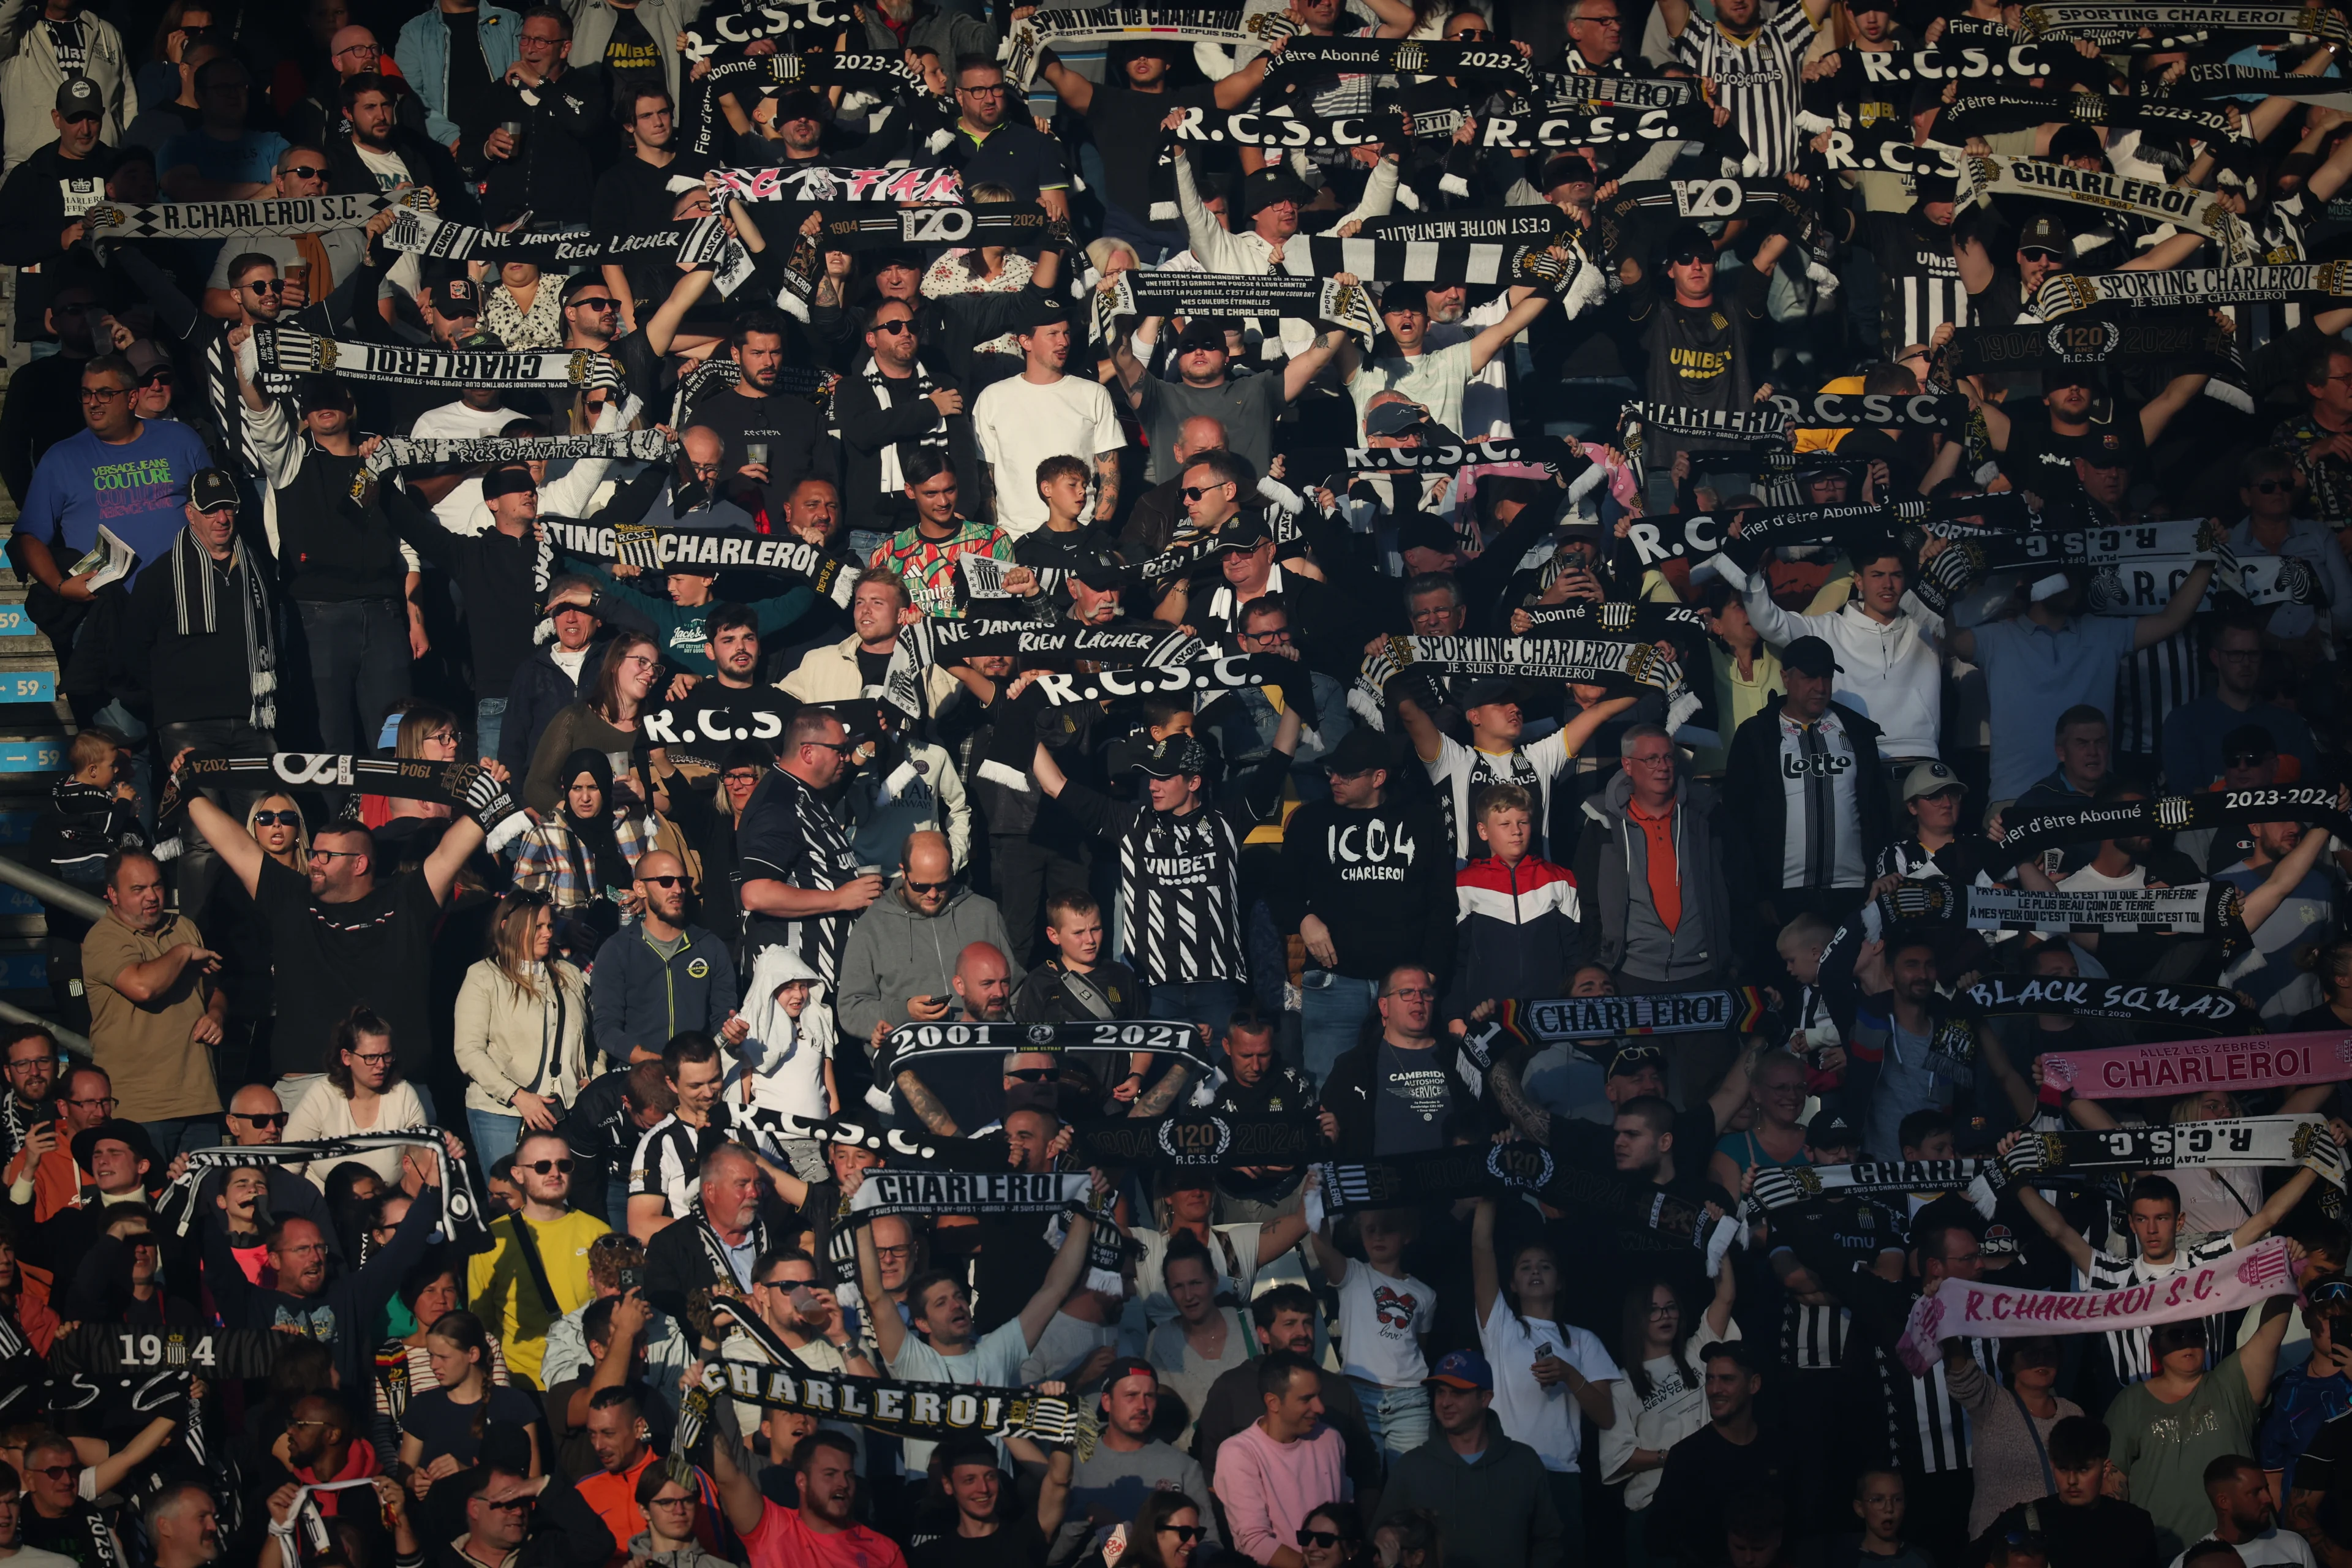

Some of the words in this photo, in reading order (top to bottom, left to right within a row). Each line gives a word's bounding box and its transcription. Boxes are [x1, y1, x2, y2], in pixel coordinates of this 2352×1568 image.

[1028, 9, 1117, 34] SPORTING
[1147, 10, 1243, 31] CHARLEROI
[2059, 10, 2158, 21] SPORTING
[2174, 7, 2285, 23] CHARLEROI
[687, 0, 851, 62] R.C.S.C.
[1181, 28, 1219, 38] DEPUIS
[1221, 31, 1246, 40] 1904
[1950, 20, 1980, 35] Fier
[1321, 49, 1379, 62] Abonné
[1860, 44, 2051, 83] R.C.S.C.
[1714, 71, 1783, 88] proximus
[2190, 64, 2230, 82] C'EST
[1177, 107, 1378, 146] R.C.S.C.
[1482, 109, 1679, 148] R.C.S.C.
[2013, 162, 2196, 216] CHARLEROI
[1615, 198, 1639, 218] 1904
[2076, 194, 2106, 204] DEPUIS
[2108, 200, 2127, 209] 1904
[830, 220, 858, 235] 1904
[1013, 215, 1043, 227] 2024
[1460, 219, 1507, 238] NOTRE
[481, 231, 511, 247] NE
[554, 243, 599, 261] RIEN
[608, 232, 680, 254] LÂCHER
[2100, 271, 2197, 298] SPORTING
[2204, 266, 2311, 295] CHARLEROI
[2130, 298, 2148, 307] JE
[2152, 296, 2182, 307] SUIS
[2185, 295, 2204, 305] DE
[2207, 290, 2286, 303] CHARLEROI
[2065, 327, 2103, 346] 120
[2123, 326, 2194, 353] 2024
[311, 337, 320, 366] R.C.S.C.
[366, 347, 543, 379] CHARLEROI
[1670, 345, 1732, 369] UNIBET
[336, 369, 368, 380] CHARLEROI
[1770, 395, 1948, 426] R.C.S.C.
[1673, 428, 1706, 436] PLAY-OFFS
[516, 443, 587, 459] FANATICS
[92, 462, 137, 477] VERSACE
[137, 458, 168, 470] JEANS
[94, 468, 173, 491] COUTURE
[617, 532, 653, 543] R.C.S.C.
[1741, 519, 1768, 542] Fier
[1772, 510, 1819, 528] d'être
[2016, 529, 2157, 557] R.C.S.C.
[657, 533, 820, 578] CHARLEROI
[2070, 556, 2086, 564] OFF
[2090, 554, 2116, 564] PLAY
[1141, 556, 1185, 580] RIEN
[1526, 604, 1586, 625] Abonné
[936, 621, 971, 645] NE
[1018, 631, 1068, 652] RIEN
[1073, 629, 1154, 650] LÂCHER
[1420, 636, 1513, 664] SPORTING
[1519, 639, 1629, 672] CHARLEROI
[1038, 652, 1263, 706] R.C.S.C.
[1445, 662, 1461, 674] JE
[1465, 663, 1495, 675] SUIS
[1499, 664, 1517, 676] DE
[1520, 665, 1596, 680] CHARLEROI
[17, 680, 39, 696] 59
[39, 749, 60, 766] 59
[192, 758, 227, 774] 2024
[399, 761, 432, 778] 1904
[478, 793, 512, 824] CHARLEROI
[2029, 815, 2076, 833] d'être
[2079, 804, 2142, 823] Abonné
[2226, 788, 2338, 810] 2023-2024
[1144, 852, 1216, 875] UNIBET
[1341, 865, 1405, 883] CHARLEROI
[1978, 908, 1997, 919] MES
[1999, 910, 2022, 921] YEUX
[2095, 912, 2113, 922] MES
[2115, 912, 2140, 922] YEUX
[2157, 912, 2183, 922] C'EST
[2032, 899, 2056, 910] PLUS
[2059, 900, 2084, 910] BEAU
[2086, 900, 2108, 910] COIN
[2109, 901, 2122, 910] DE
[2125, 900, 2155, 911] TERRE
[1967, 979, 2088, 1006] BLACK
[2103, 985, 2237, 1020] SQUAD
[1536, 995, 1727, 1033] CHARLEROI
[2073, 1008, 2105, 1017] SINCE
[2108, 1010, 2132, 1019] 2020
[892, 1024, 992, 1055] 2001
[1092, 1024, 1191, 1050] 2021
[2139, 1047, 2181, 1058] ALLEZ
[2185, 1045, 2210, 1055] LES
[2214, 1041, 2271, 1054] ZEBRES!
[2102, 1047, 2312, 1089] CHARLEROI
[1410, 1085, 1442, 1098] SERVICE
[1175, 1124, 1214, 1148] 120
[2099, 1128, 2252, 1156] R.C.S.C.
[2176, 1155, 2206, 1164] PLAY
[876, 1174, 1063, 1203] CHARLEROI
[1324, 1162, 1343, 1208] CHARLEROI
[1855, 1186, 1869, 1194] SUIS
[1882, 1183, 1915, 1193] CHARLEROI
[876, 1207, 891, 1215] SUIS
[1966, 1283, 2157, 1323] R.CHARLEROI
[2163, 1269, 2222, 1307] S.C.
[701, 1361, 1001, 1430] CHARLEROI
[1642, 1379, 1681, 1406] DANCE
[1644, 1394, 1667, 1412] NEW
